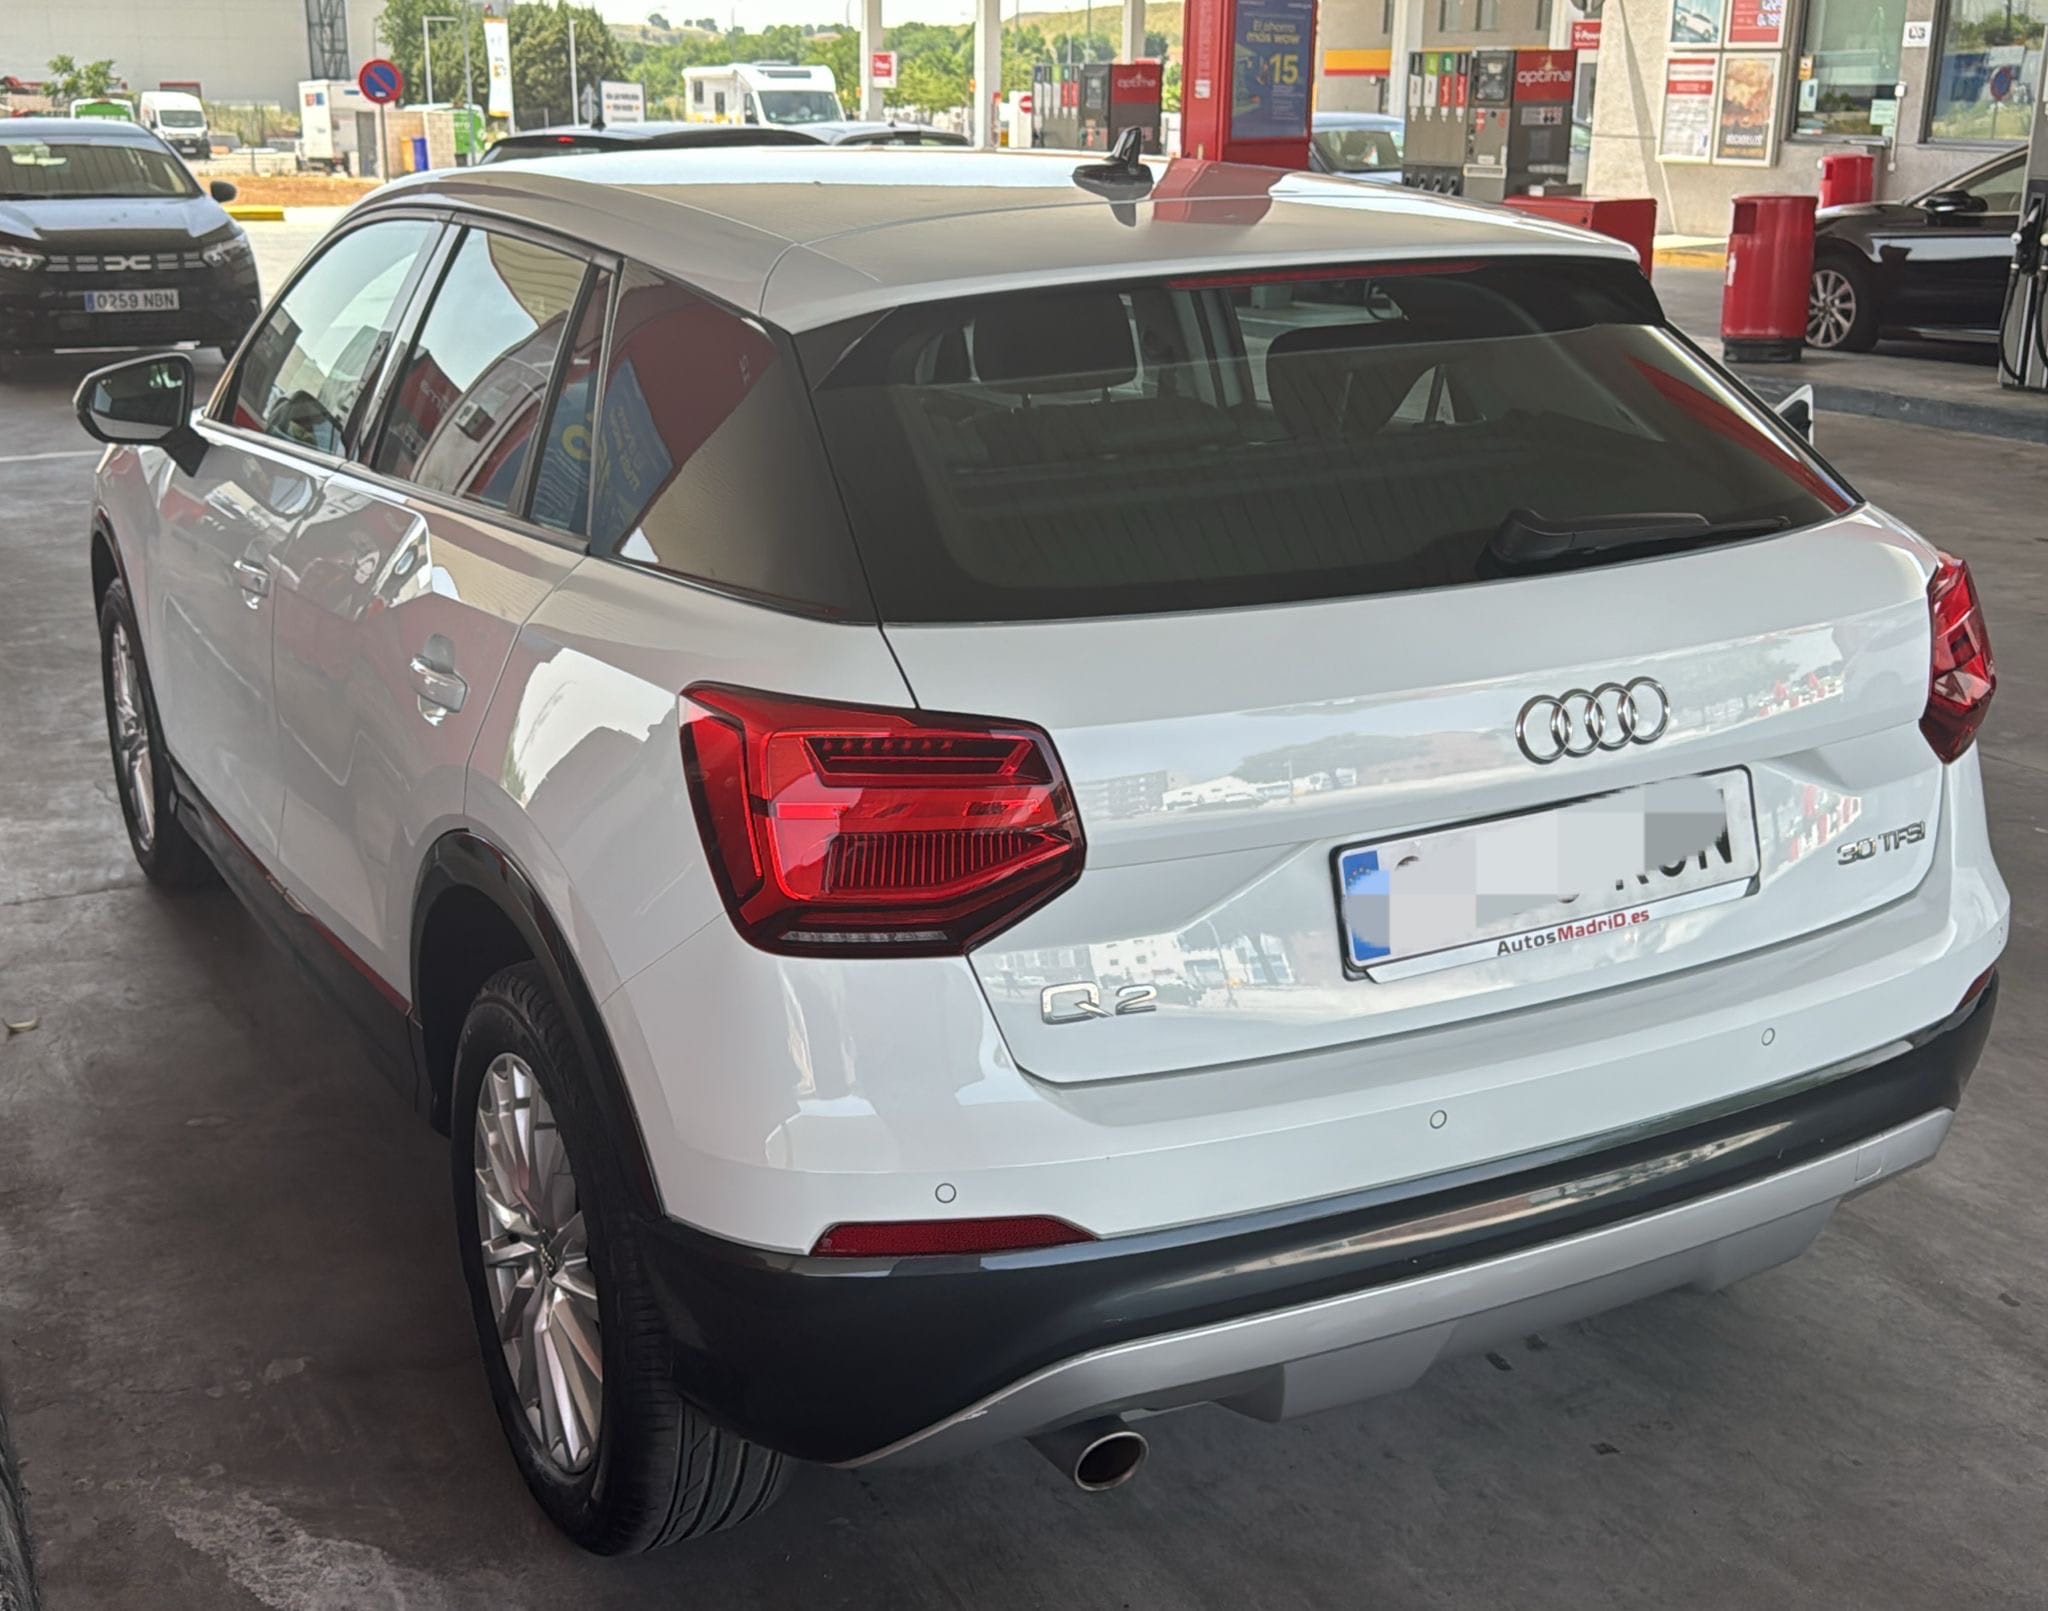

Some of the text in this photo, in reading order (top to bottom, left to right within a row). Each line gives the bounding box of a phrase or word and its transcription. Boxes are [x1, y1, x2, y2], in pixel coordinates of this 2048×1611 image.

[1269, 52, 1298, 86] 15
[1517, 70, 1572, 87] optima
[97, 291, 175, 309] 0259 NBN
[1836, 820, 1926, 866] 30 TFSI
[1496, 909, 1651, 957] AutosMadriD.es
